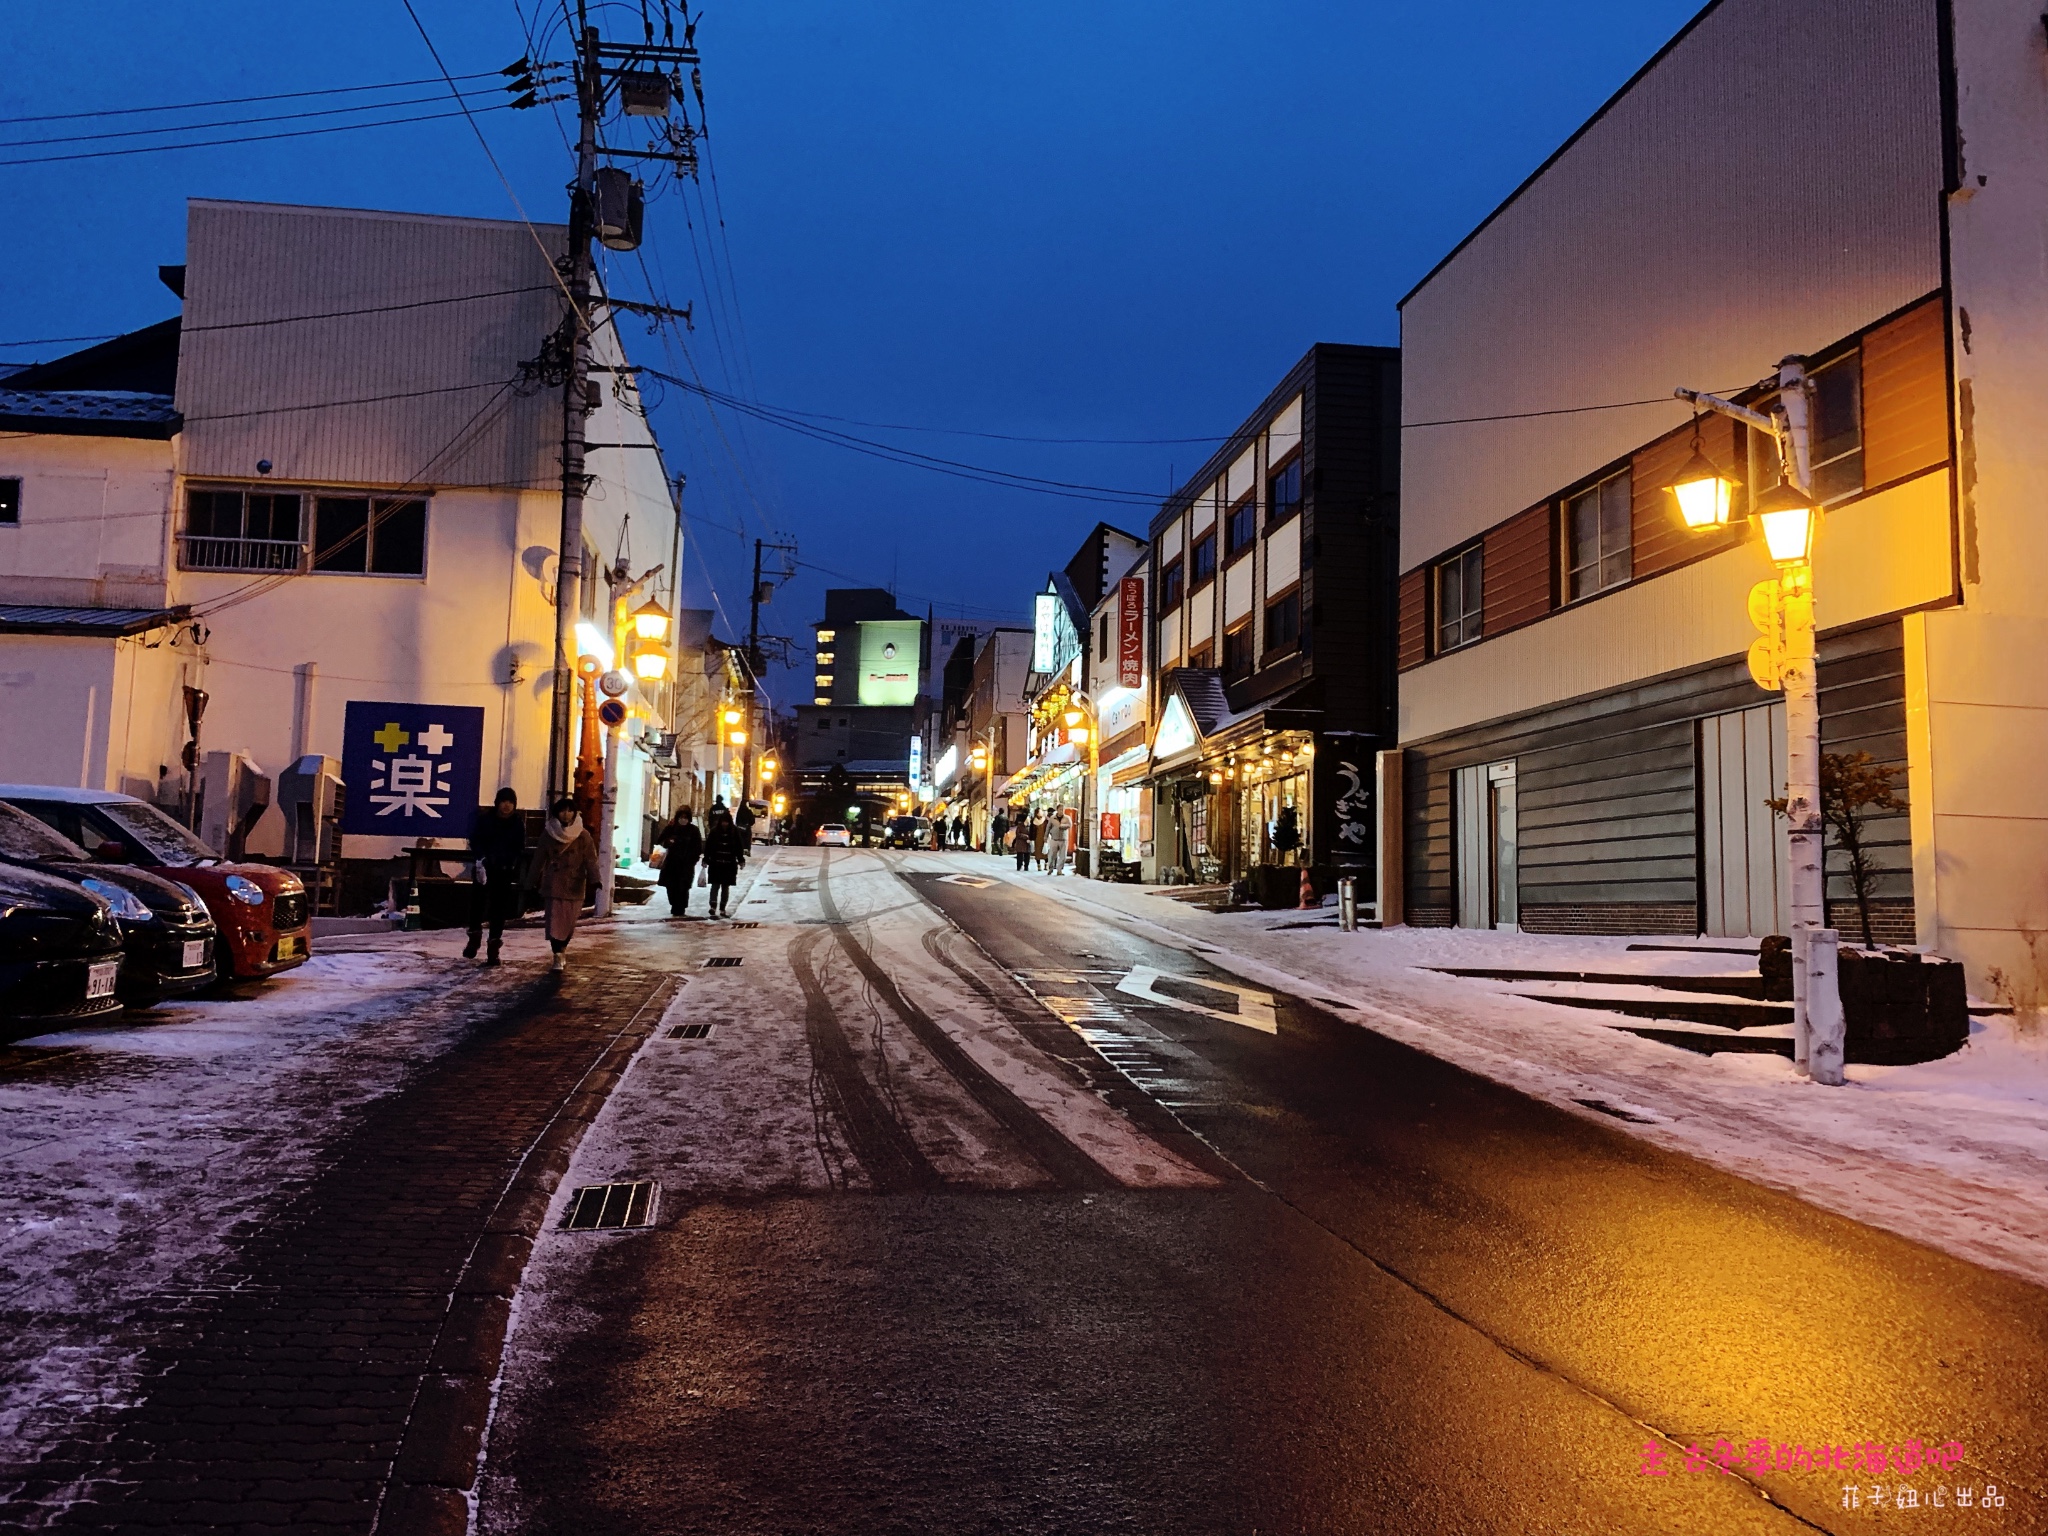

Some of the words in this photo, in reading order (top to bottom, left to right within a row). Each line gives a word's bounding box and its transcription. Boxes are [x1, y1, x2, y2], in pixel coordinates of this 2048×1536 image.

[1123, 581, 1139, 685] さっぽろラーメン・焼肉
[606, 677, 623, 690] 30
[1334, 761, 1370, 845] うさぎや
